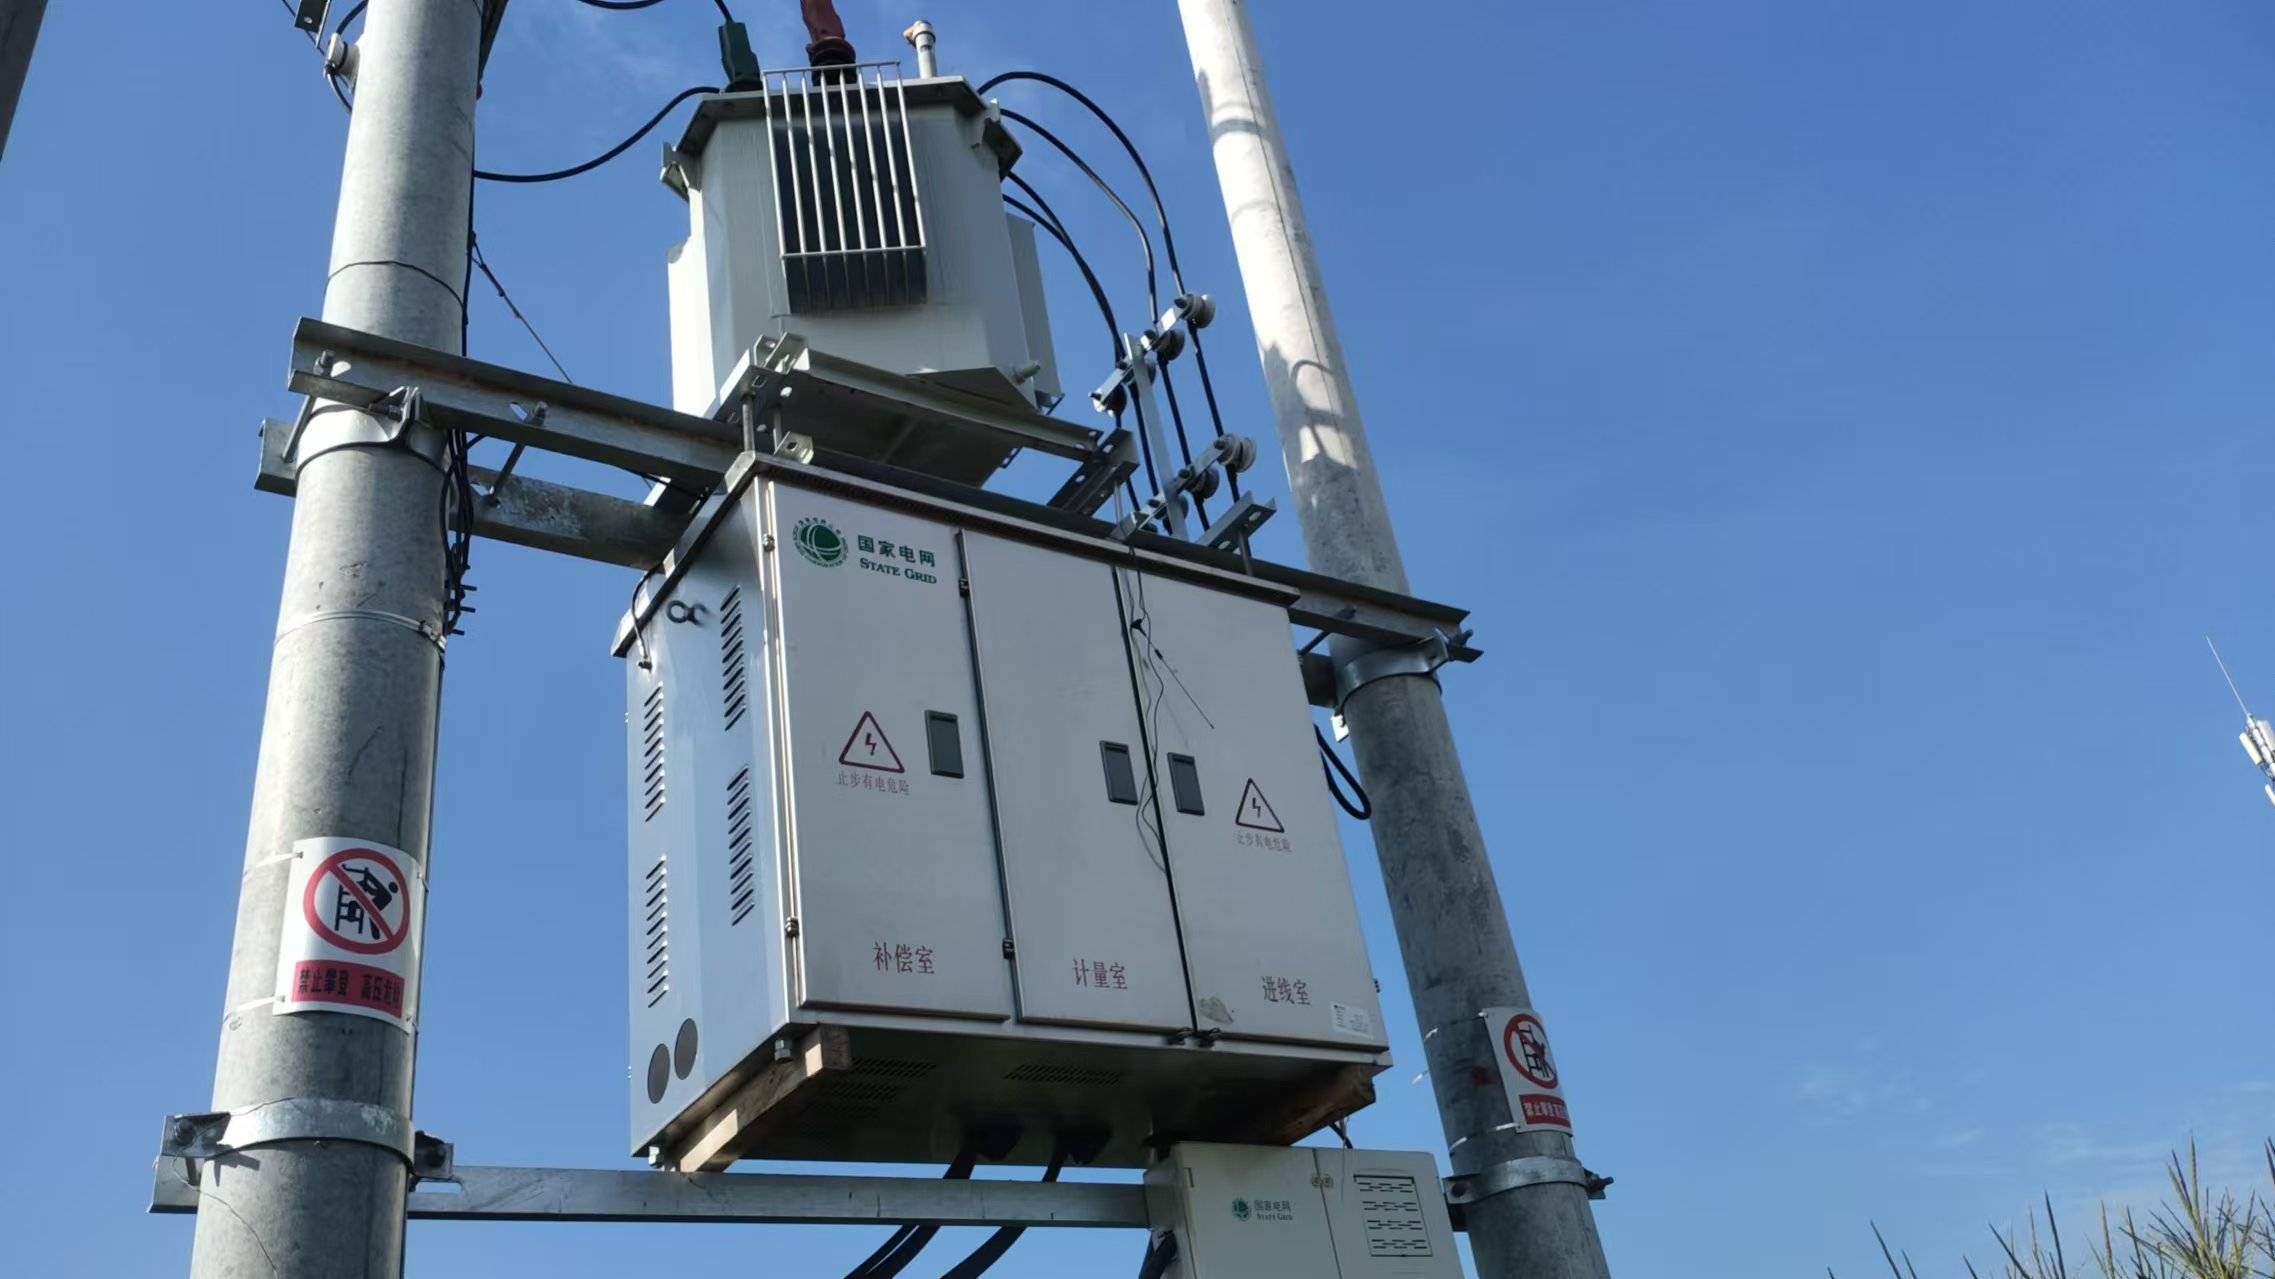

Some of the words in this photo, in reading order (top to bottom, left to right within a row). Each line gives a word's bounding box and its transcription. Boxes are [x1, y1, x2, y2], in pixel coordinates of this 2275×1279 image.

[857, 534, 936, 568] 国家电网
[860, 557, 900, 578] STATE
[903, 568, 937, 584] GRID
[873, 942, 935, 975] 补偿室
[1073, 958, 1129, 990] 计量室
[1261, 976, 1311, 1006] 进线室
